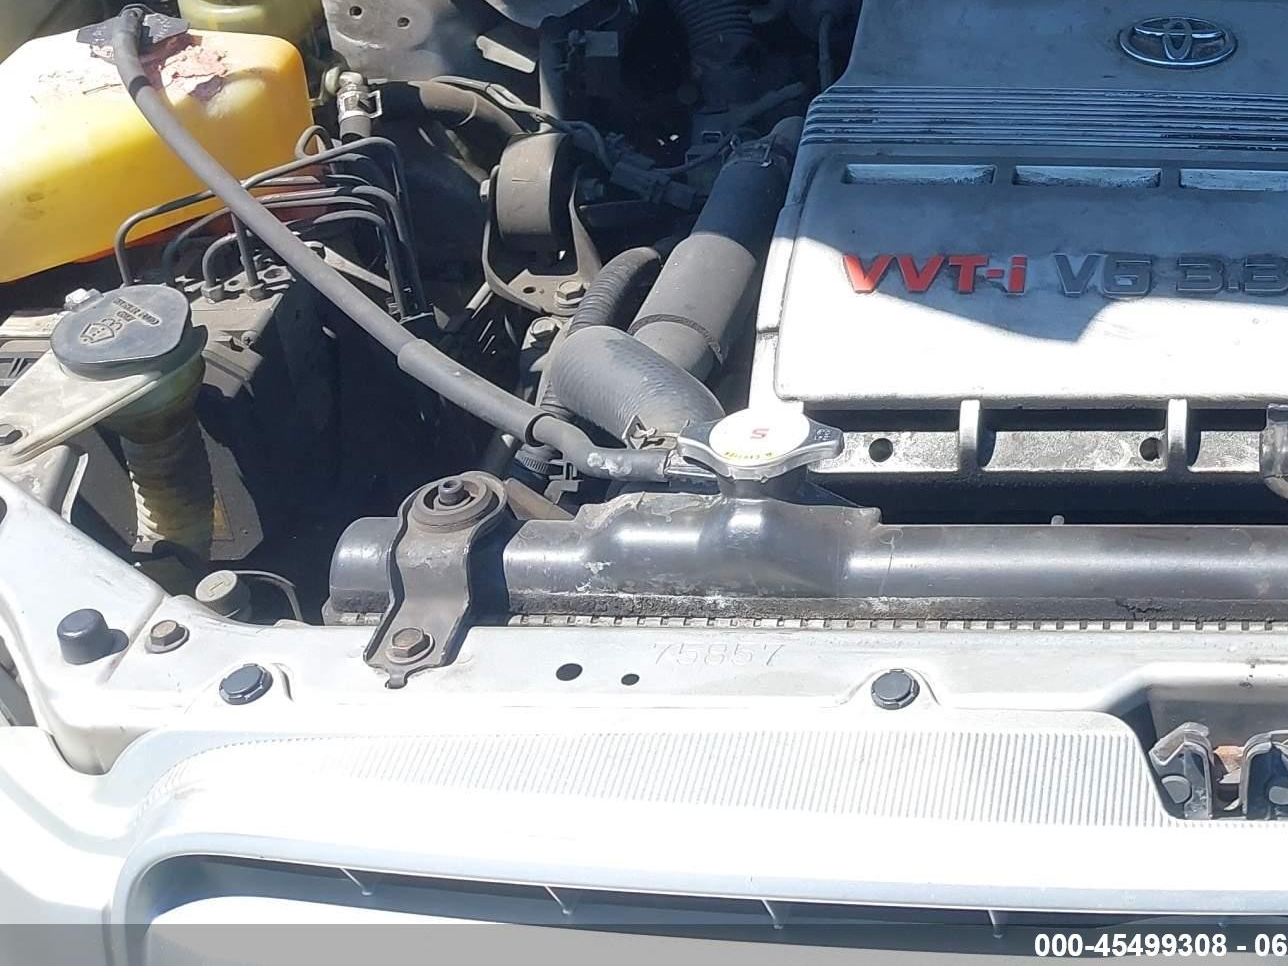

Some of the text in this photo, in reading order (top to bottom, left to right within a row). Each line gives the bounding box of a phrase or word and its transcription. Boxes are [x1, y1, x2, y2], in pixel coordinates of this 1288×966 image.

[843, 253, 1027, 295] VVT-i
[1053, 252, 1155, 297] V6
[651, 641, 786, 667] 75857
